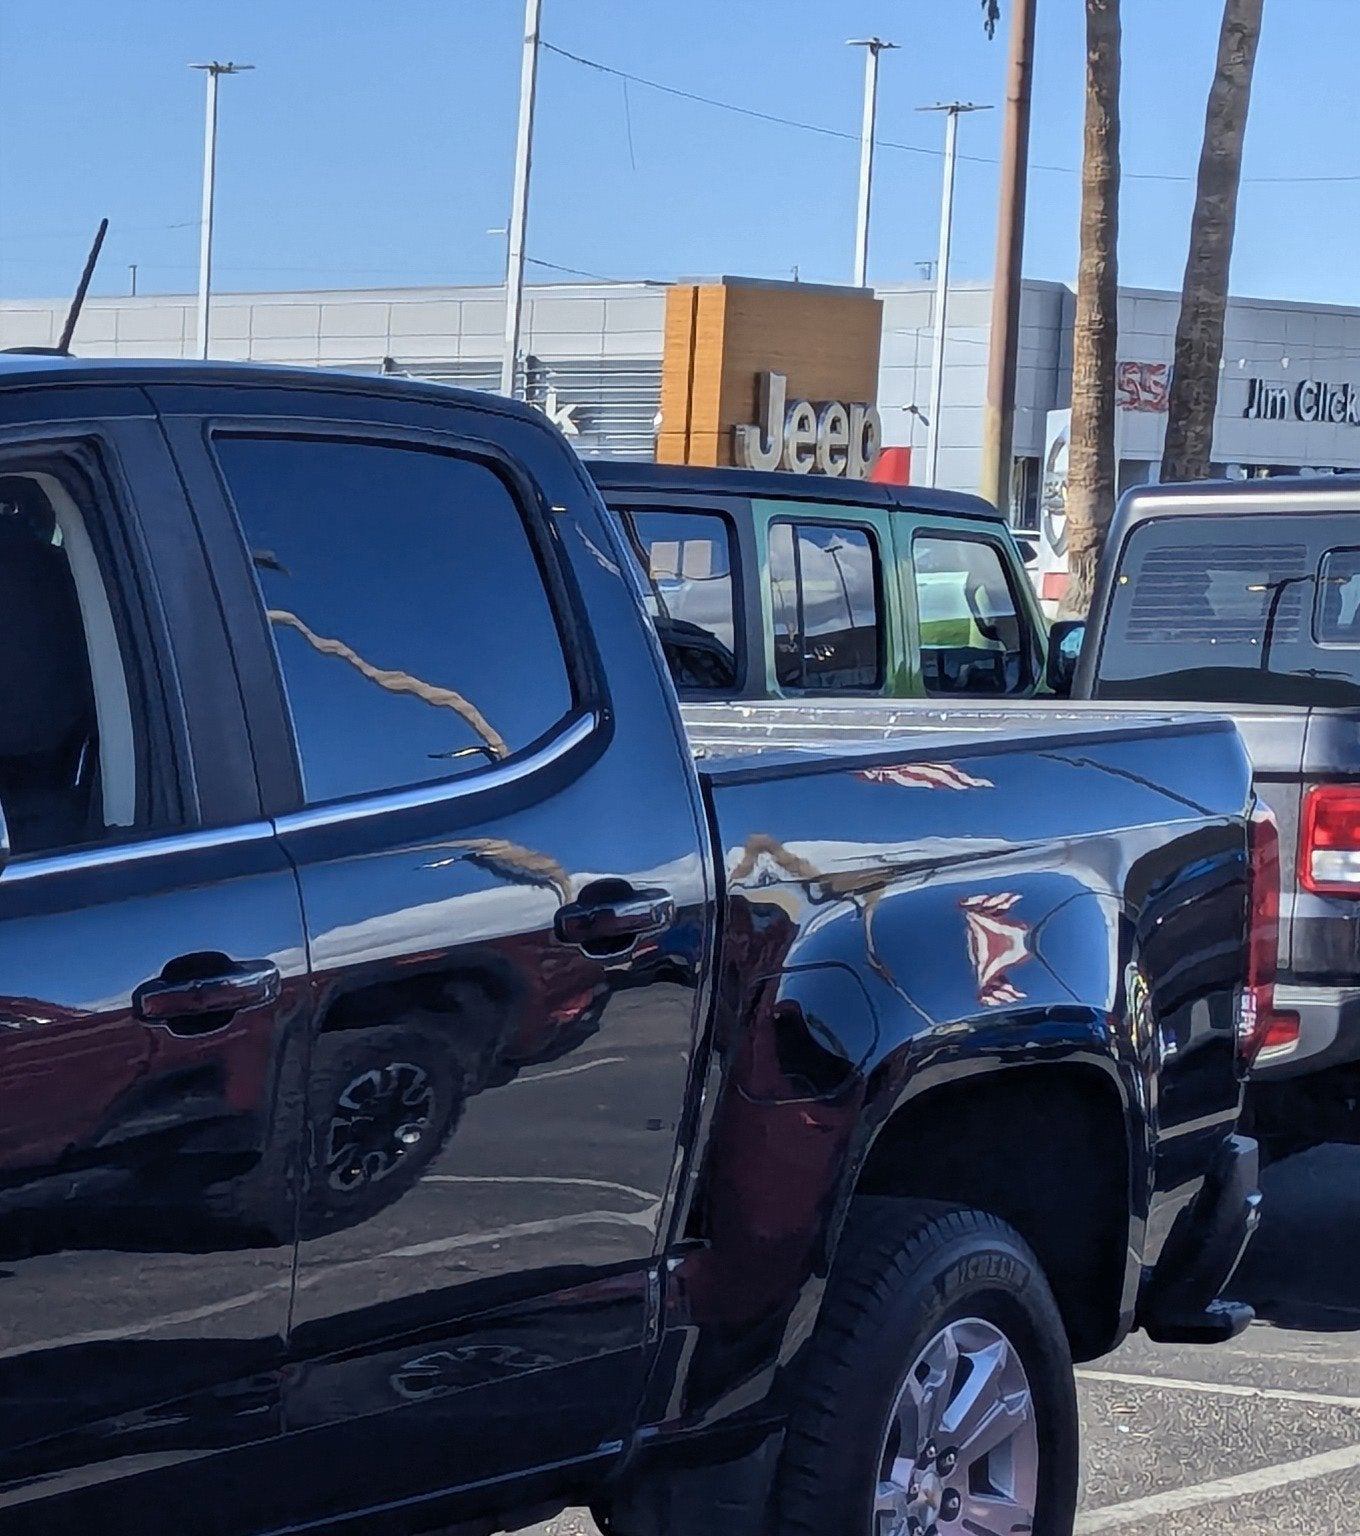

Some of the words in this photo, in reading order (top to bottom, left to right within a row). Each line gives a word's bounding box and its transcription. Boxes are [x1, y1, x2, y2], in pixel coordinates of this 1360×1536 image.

[733, 371, 881, 479] Jeep
[1244, 378, 1291, 420] Jim
[1295, 379, 1360, 424] Click
